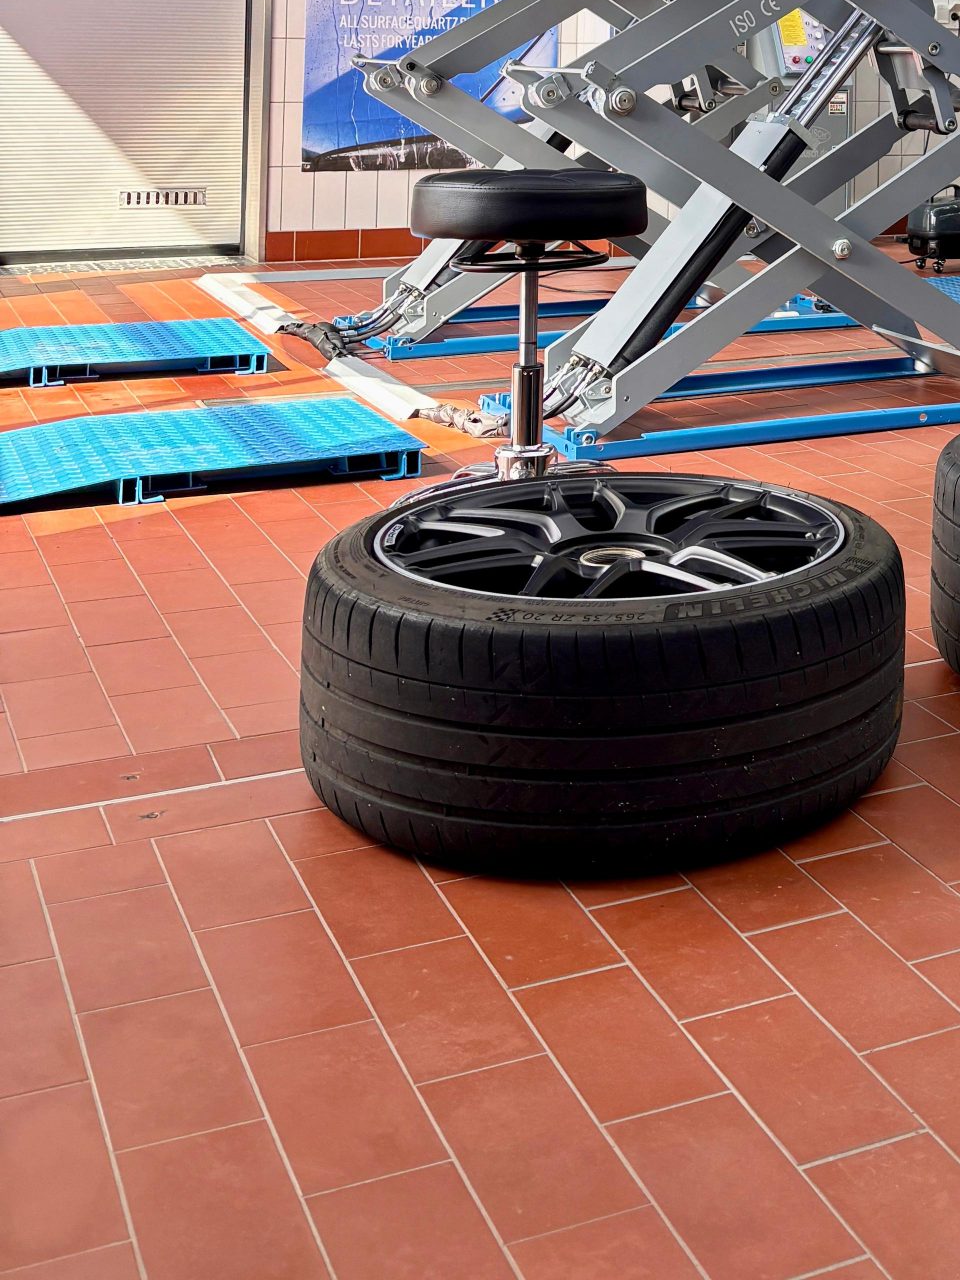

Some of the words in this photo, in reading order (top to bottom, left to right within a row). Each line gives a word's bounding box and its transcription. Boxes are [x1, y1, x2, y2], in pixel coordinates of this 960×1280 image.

[339, 14, 358, 28] ALL
[729, 10, 756, 37] ISO
[381, 34, 402, 49] FOR
[404, 34, 437, 50] YEA
[677, 571, 847, 619] MICHELIN
[522, 612, 545, 622] 20
[551, 613, 576, 622] ZR
[583, 612, 646, 622] 265/35
